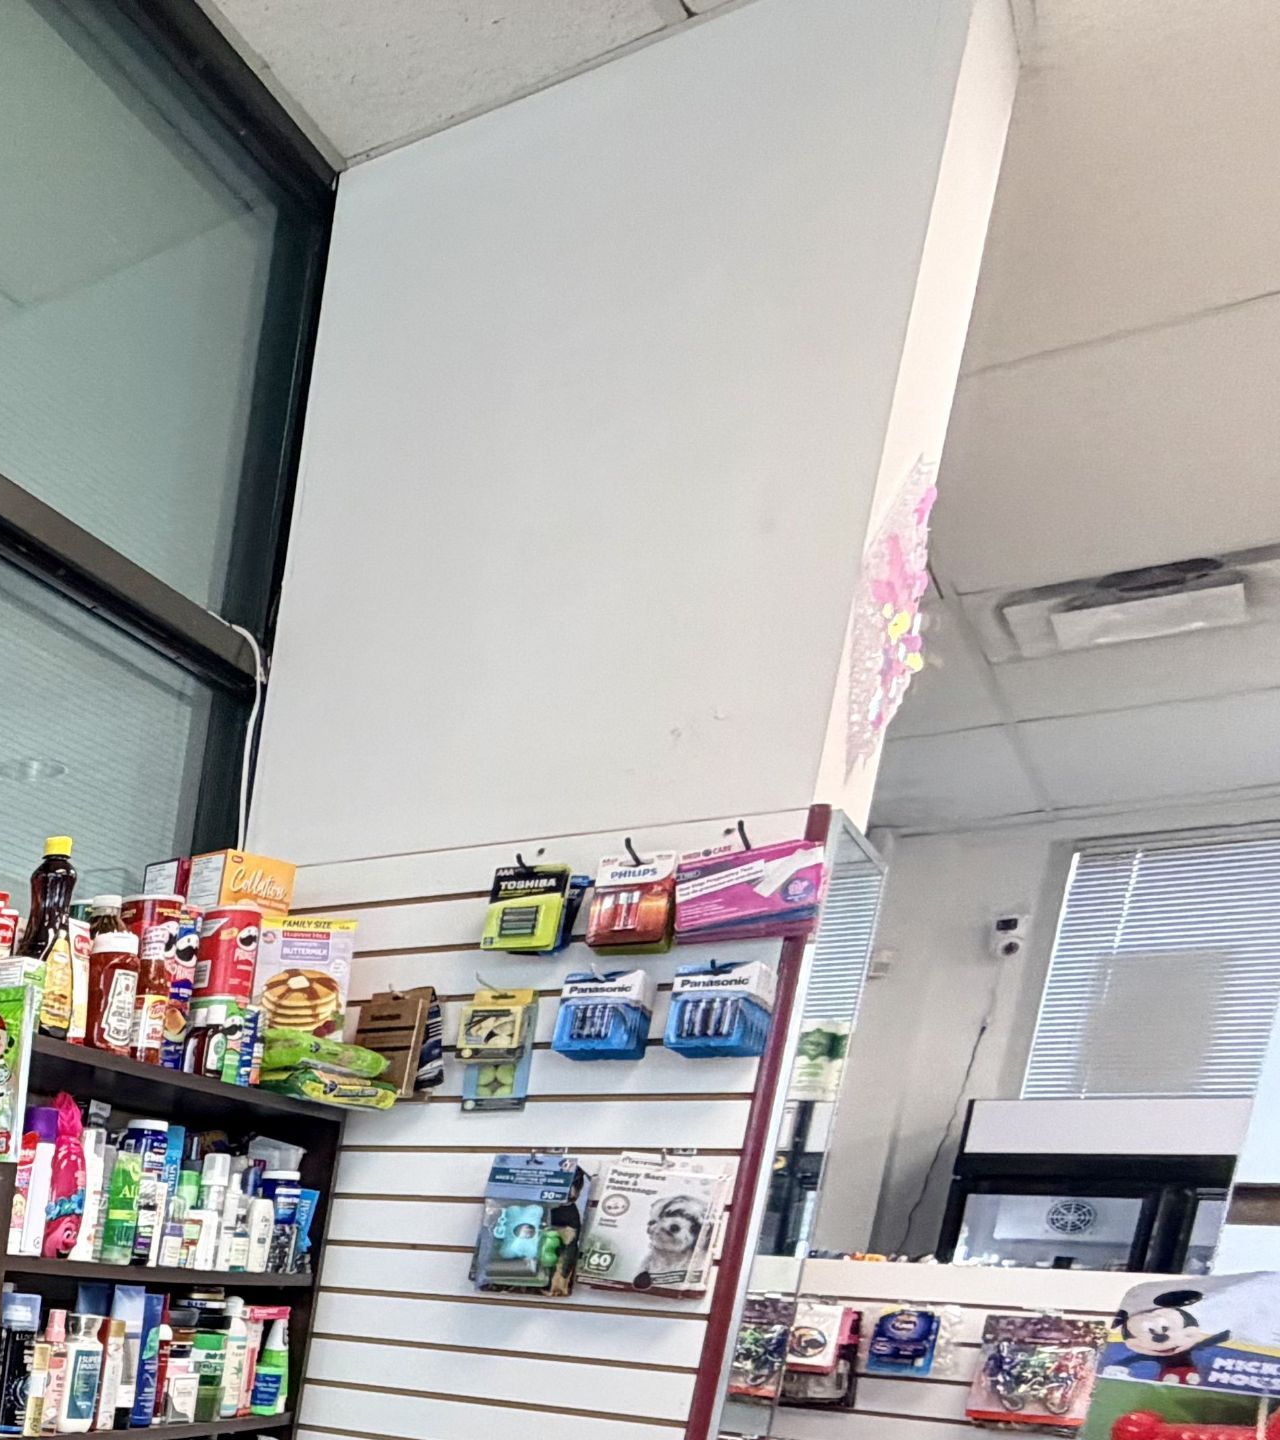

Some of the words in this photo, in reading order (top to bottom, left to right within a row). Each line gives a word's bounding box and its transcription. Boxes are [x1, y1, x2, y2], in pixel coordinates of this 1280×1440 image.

[611, 866, 658, 881] PHILIPS
[500, 877, 557, 891] TOSHIBA
[282, 919, 311, 930] FAMILY
[314, 919, 333, 929] SIZE
[681, 975, 750, 988] Panasonic
[569, 982, 633, 996] Panasonic
[588, 1251, 612, 1268] 60
